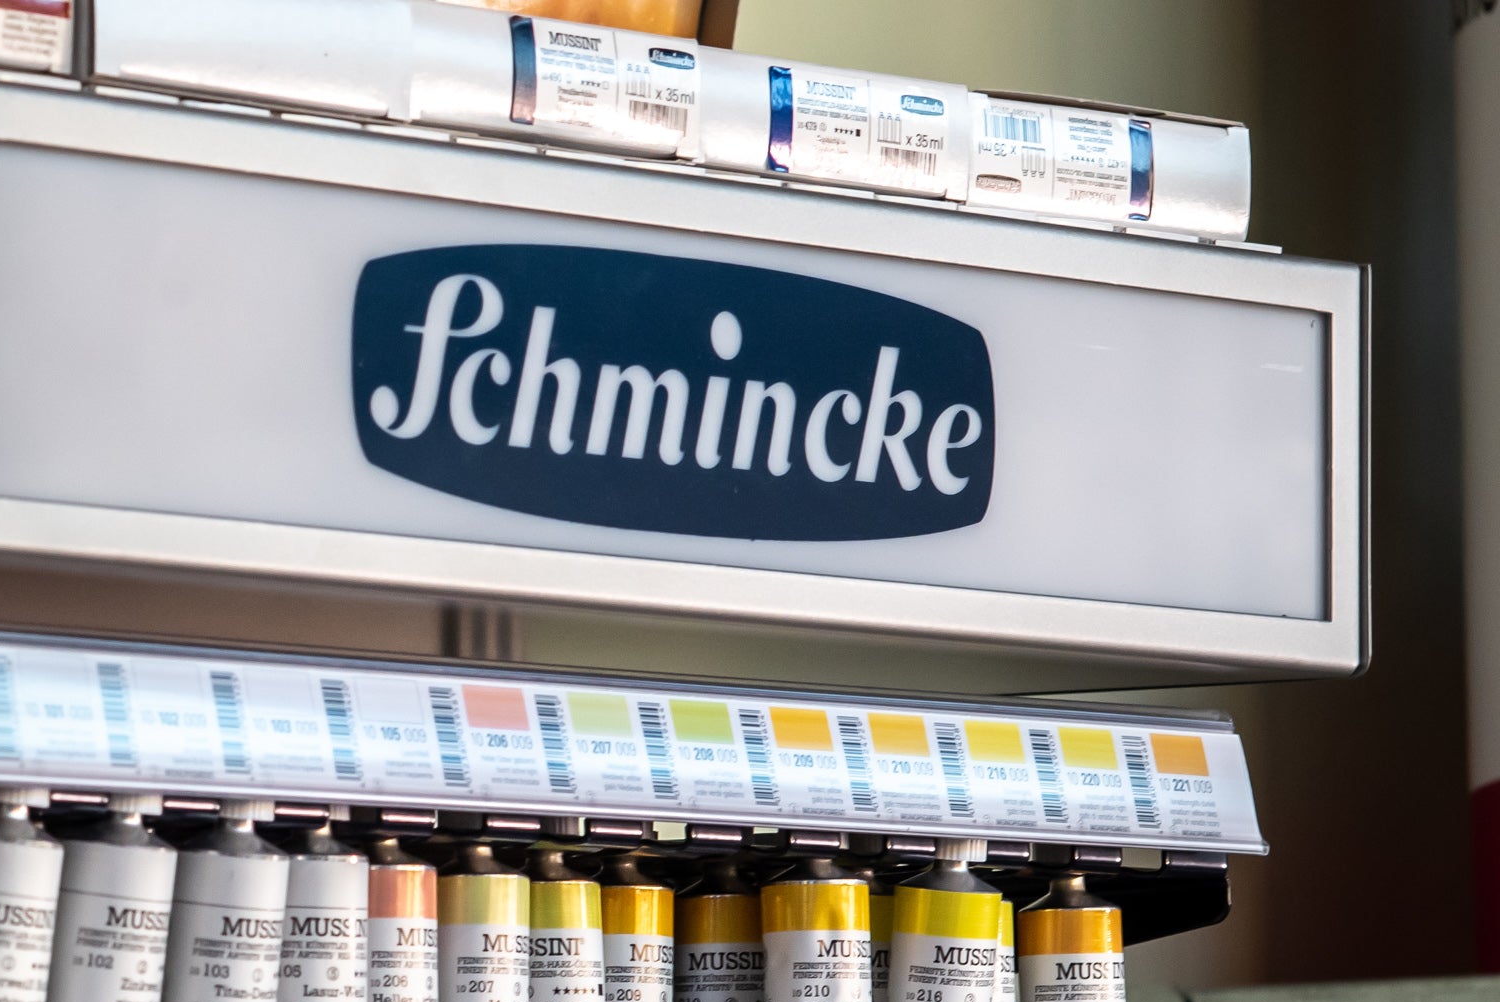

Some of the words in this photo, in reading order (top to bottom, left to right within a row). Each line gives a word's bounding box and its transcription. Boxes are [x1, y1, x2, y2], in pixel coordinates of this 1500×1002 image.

[370, 273, 983, 496] Schmincke
[381, 726, 400, 741] 105
[486, 733, 509, 749] 206
[591, 740, 612, 755] 207
[693, 747, 714, 762] 208
[793, 753, 814, 768] 209
[892, 760, 912, 775] 210
[987, 766, 1007, 781] 216
[1080, 772, 1100, 787] 220
[1172, 778, 1192, 793] 221
[87, 953, 114, 969] 102
[203, 963, 230, 979] 103
[383, 975, 409, 988] 206
[468, 979, 495, 993] 207
[617, 989, 642, 1002] 209
[804, 985, 831, 998] 210
[917, 989, 943, 1002] 216
